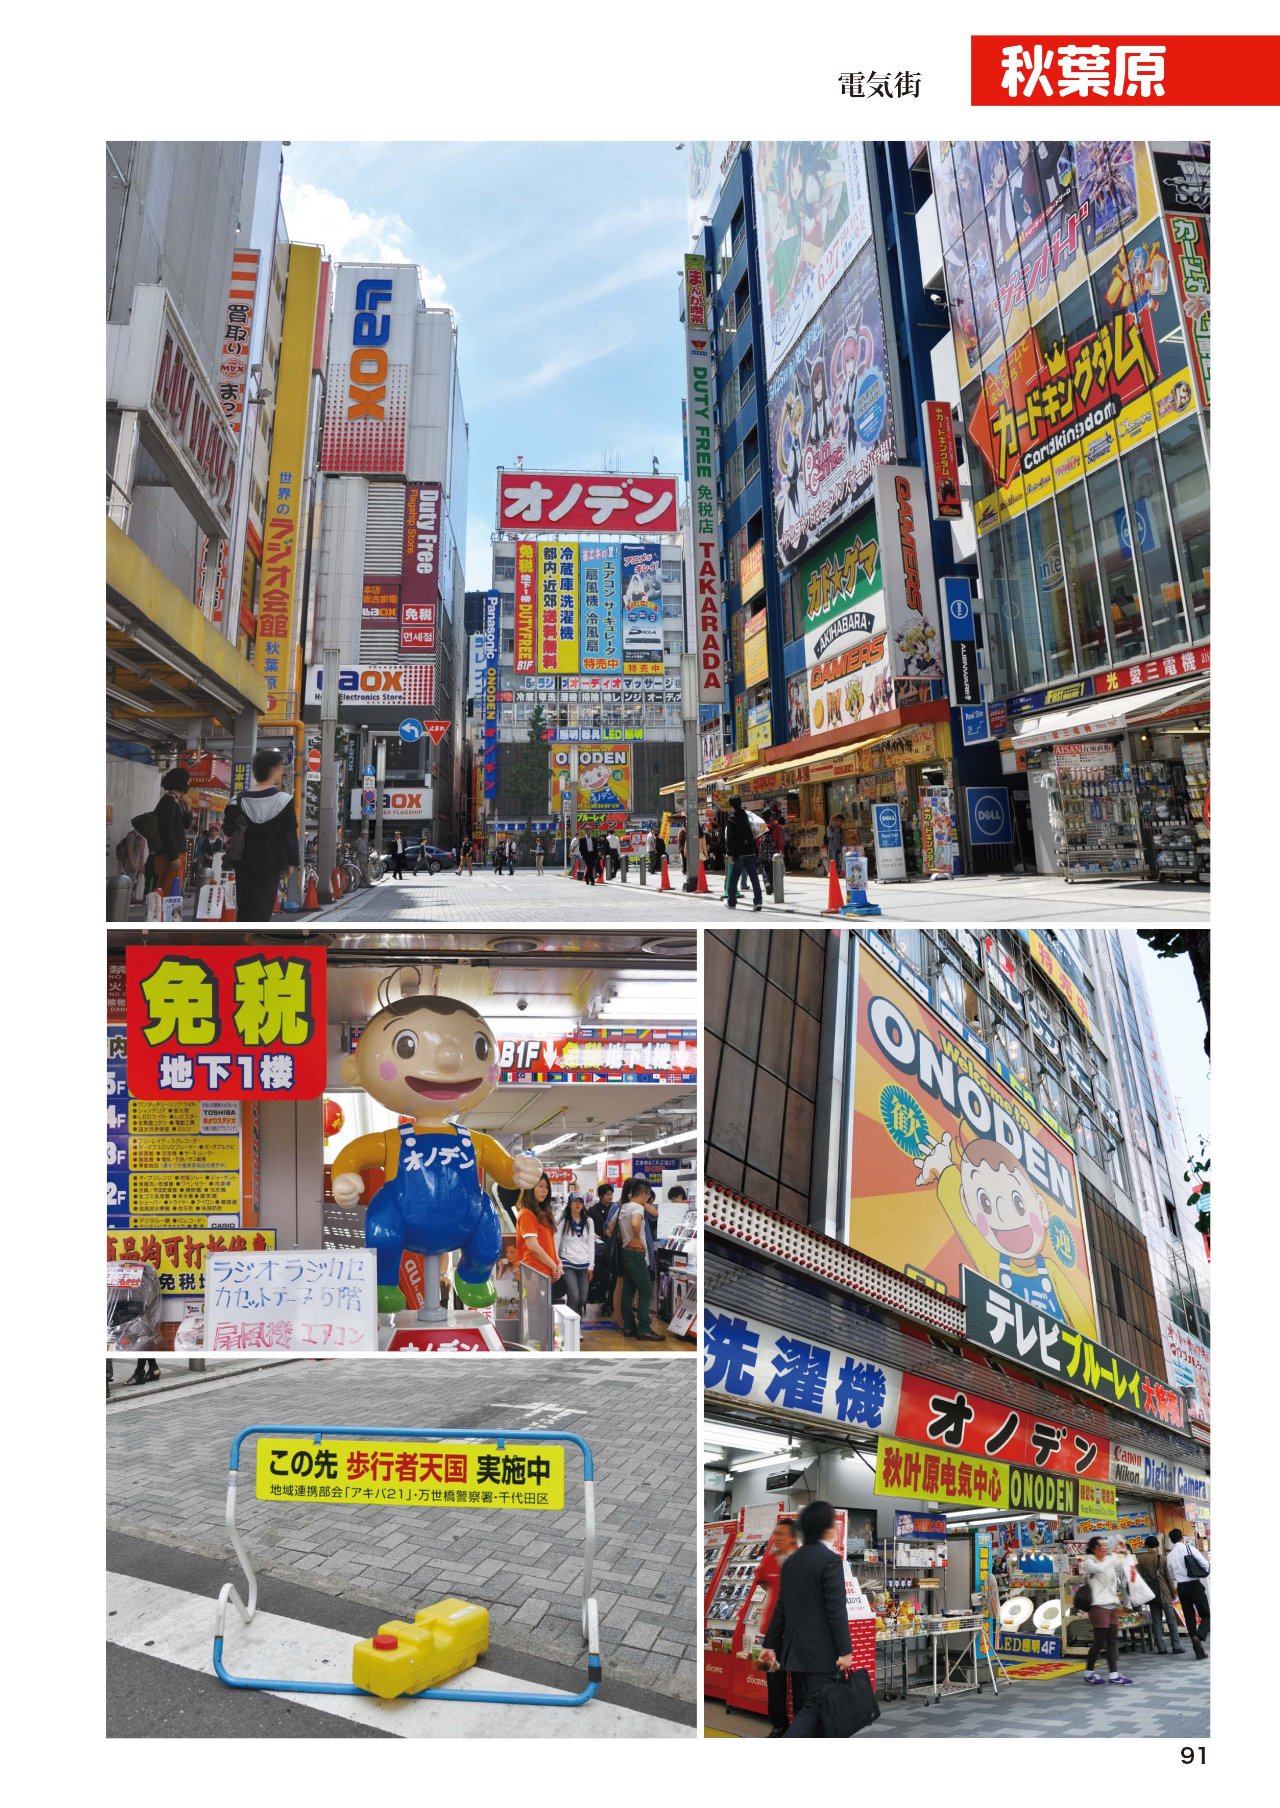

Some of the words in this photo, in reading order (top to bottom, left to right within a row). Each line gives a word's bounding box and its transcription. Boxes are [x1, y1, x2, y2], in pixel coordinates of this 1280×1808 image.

[687, 270, 705, 324] まんが喫茶
[225, 304, 250, 355] 買取り
[692, 367, 710, 420] DUTY
[993, 314, 1157, 480] カードキングダム
[696, 425, 712, 478] FREE
[276, 472, 292, 515] 世界の
[407, 489, 418, 526] Flagship
[417, 490, 439, 530] Duty
[504, 479, 673, 525] オノデン
[697, 485, 715, 534] 免税店
[407, 526, 417, 553] Store
[417, 534, 437, 574] Free
[895, 476, 923, 614] GAMERS
[260, 518, 294, 638] ラジオ会館
[560, 547, 573, 592] 冷蔵庫
[405, 608, 432, 621] 免税
[487, 597, 498, 659] Panasonic
[560, 595, 573, 640] 洗濯機
[699, 543, 721, 688] TAKARADA
[820, 614, 869, 650] AKIHABARA
[404, 632, 432, 643] 면세점
[264, 641, 280, 689] 秋葉原
[517, 661, 533, 670] B1F
[584, 658, 619, 670] 特売中
[628, 664, 660, 673] 特売中
[811, 633, 888, 689] GAMERS
[1107, 672, 1118, 691] 光
[1130, 652, 1196, 686] 愛三電機
[487, 668, 496, 720] ONODEN
[966, 712, 974, 721] Real
[975, 710, 983, 718] Site
[555, 751, 626, 765] OODEN
[1055, 746, 1081, 755] AISAN
[978, 811, 1001, 820] DELL
[141, 958, 309, 1047] 免税
[160, 1055, 295, 1090] 地下1楼
[502, 1040, 542, 1071] B1F
[938, 1031, 1013, 1114] Welcome
[107, 1105, 126, 1128] 4F
[867, 996, 1076, 1215] ONODEN
[890, 1089, 922, 1143] 歓
[107, 1141, 126, 1165] 3F
[404, 1146, 474, 1172] オノデン
[107, 1182, 126, 1205] 2F
[214, 1260, 279, 1283] ラジオ
[285, 1258, 365, 1283] ラジカセ
[404, 1259, 421, 1286] au
[213, 1321, 294, 1351] 扇風機
[301, 1323, 365, 1345] エアコン
[986, 1289, 1060, 1371] テレビ
[1062, 1331, 1140, 1409] ブルーレイ
[705, 1315, 887, 1430] 洗濯機
[927, 1392, 1097, 1475] オノデン
[270, 1450, 337, 1480] この先
[347, 1451, 468, 1484] 歩行者天国
[477, 1454, 550, 1486] 実施中
[1114, 1445, 1142, 1467] Canon
[1115, 1463, 1140, 1485] Nikon
[270, 1484, 549, 1505] 地域連携部会「アキバ21」・万世橋警察署・千代田区
[1010, 1468, 1074, 1513] ONODEN
[1144, 1456, 1176, 1496] Digital
[1177, 1467, 1206, 1499] Camera
[997, 1637, 1040, 1654] LED照明
[1041, 1640, 1056, 1655] 4F
[705, 1663, 723, 1674] docomo
